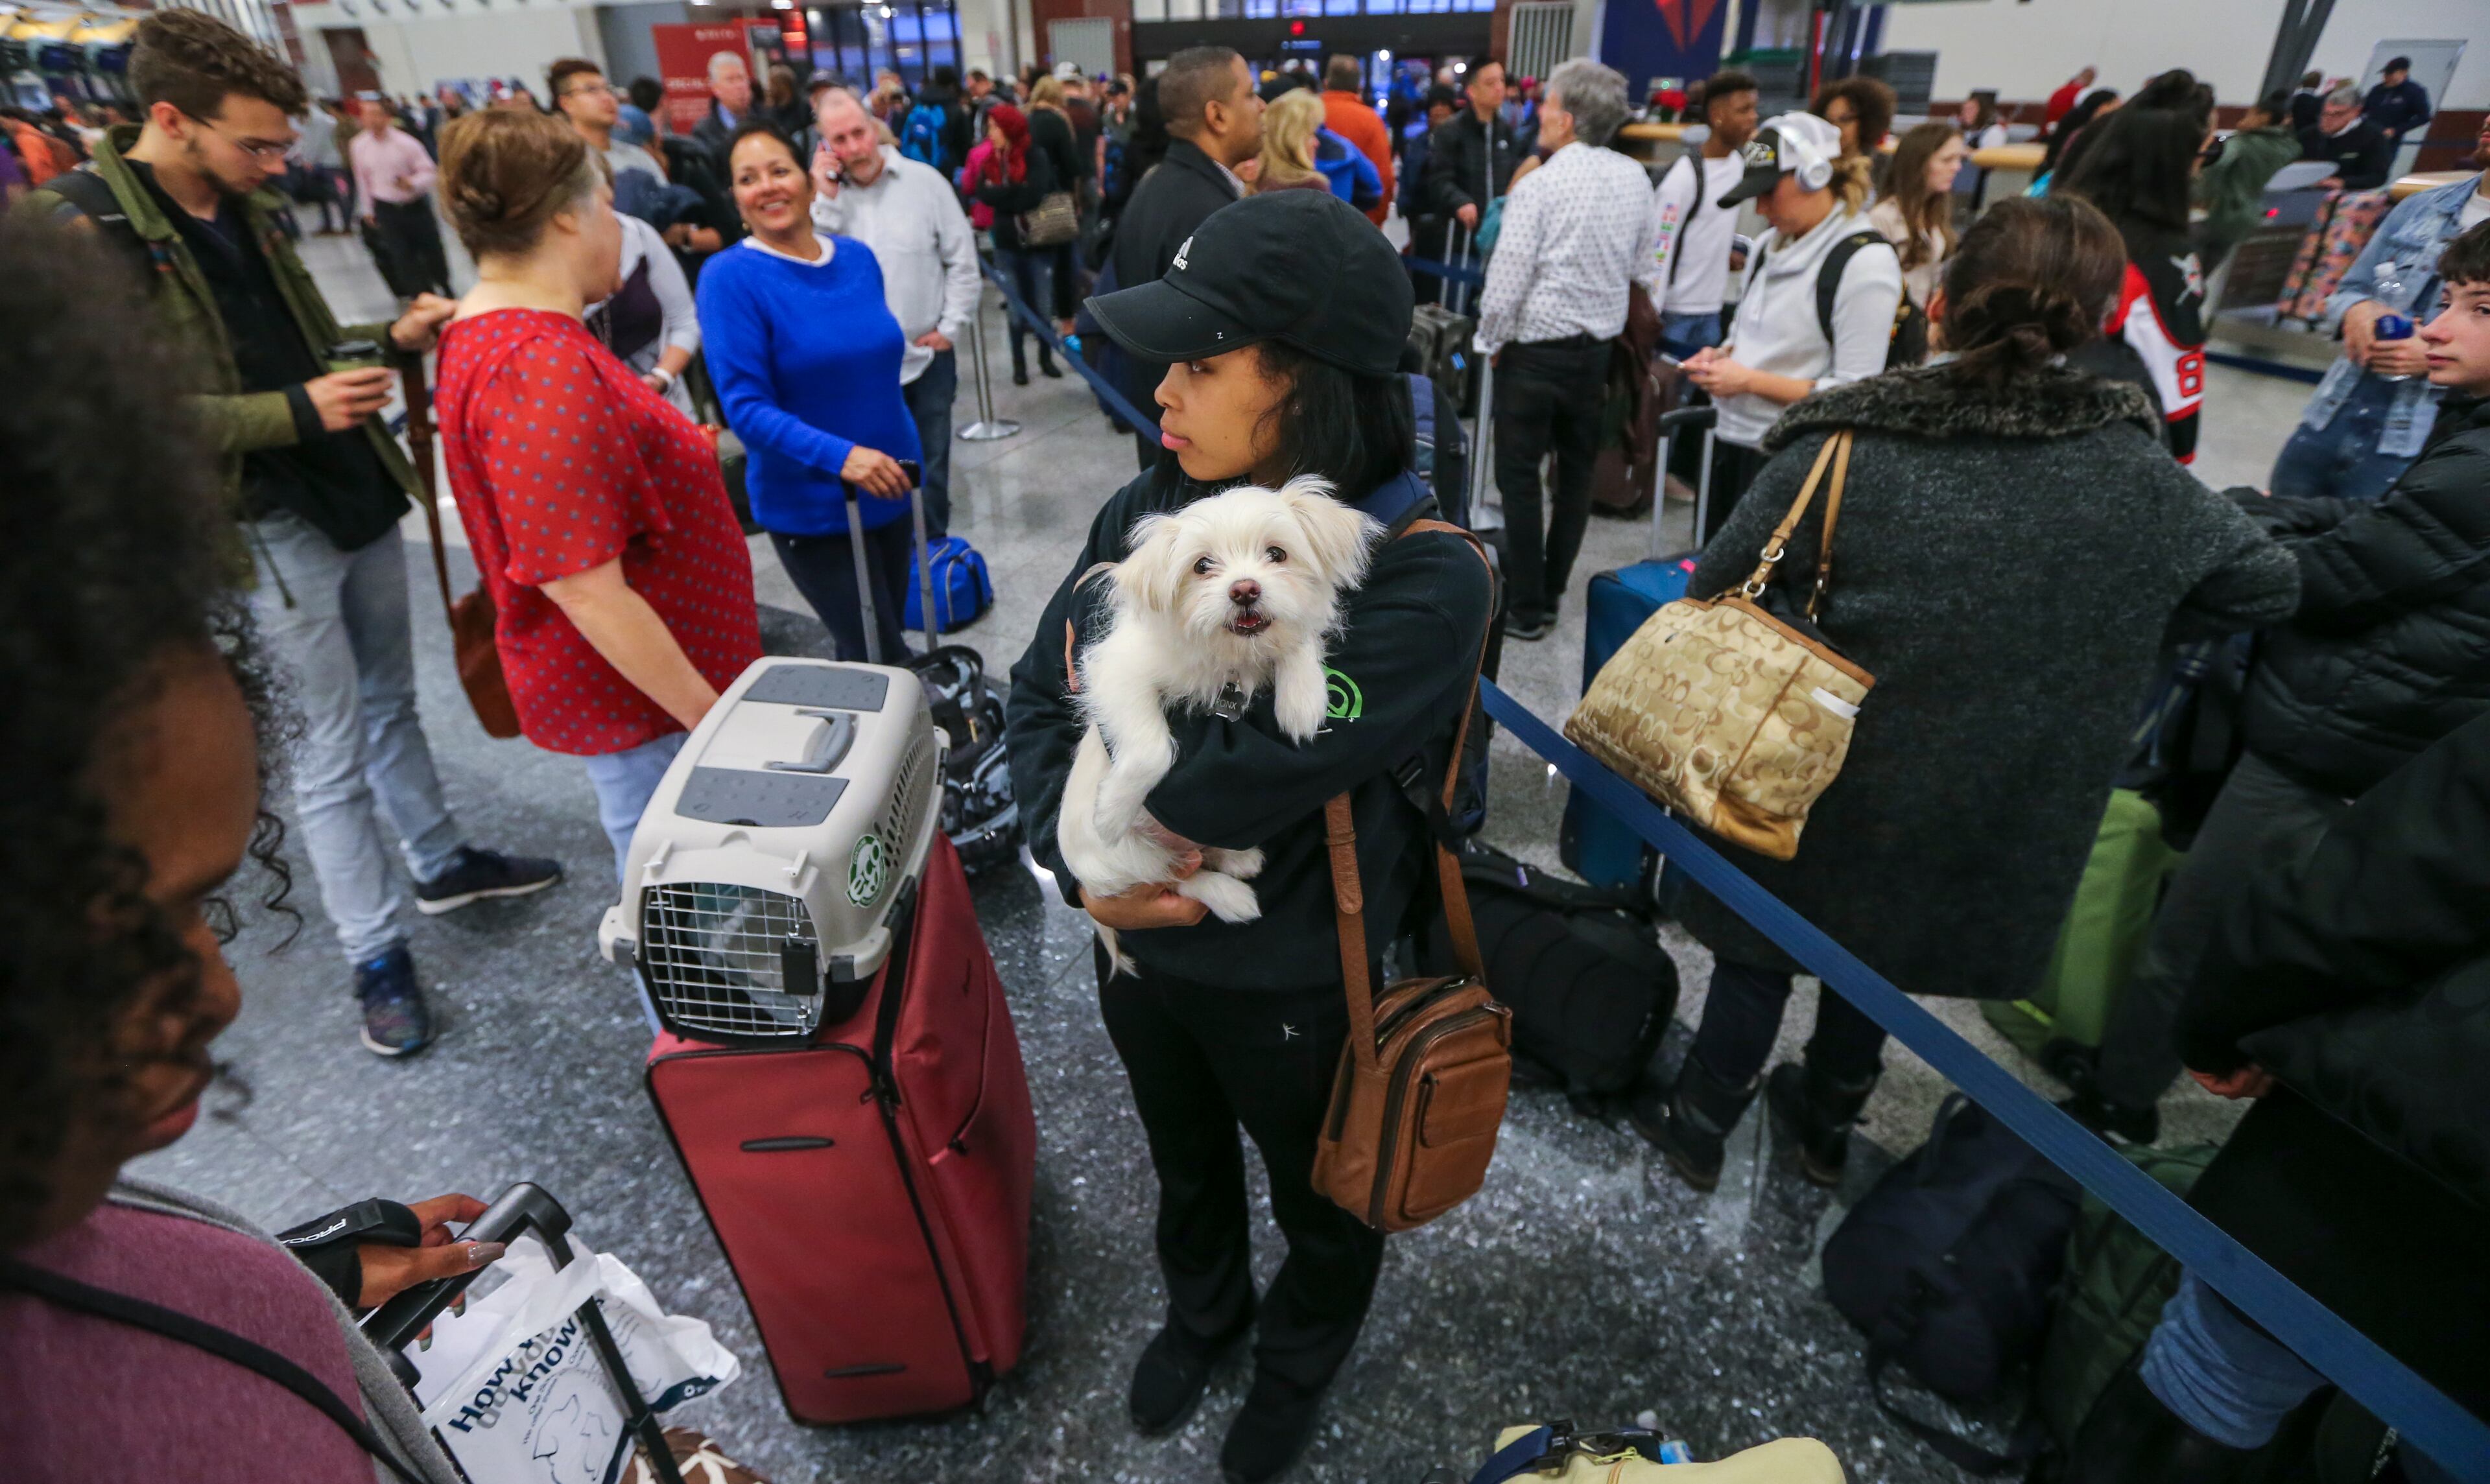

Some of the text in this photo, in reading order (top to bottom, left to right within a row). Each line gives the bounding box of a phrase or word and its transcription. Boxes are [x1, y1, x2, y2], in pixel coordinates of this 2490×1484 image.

[2176, 353, 2206, 397] 8
[1215, 699, 1238, 711] RONX
[510, 1317, 578, 1402] know
[448, 1358, 513, 1433] How
